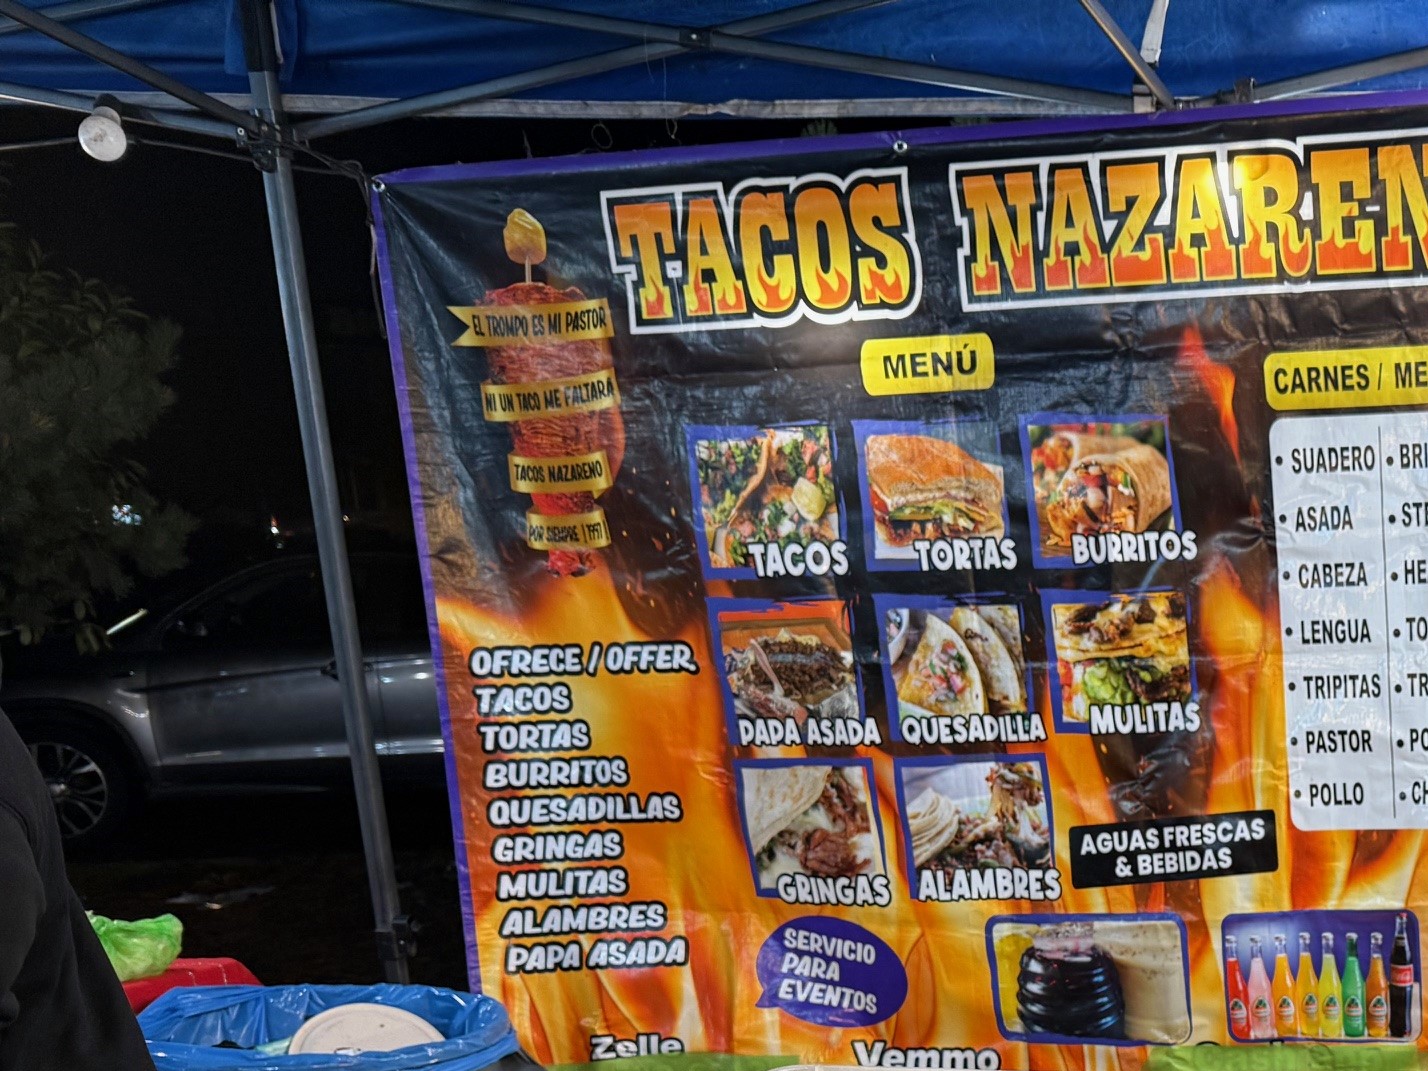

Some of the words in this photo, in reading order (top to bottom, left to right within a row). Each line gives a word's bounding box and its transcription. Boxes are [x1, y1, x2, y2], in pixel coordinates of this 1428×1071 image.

[612, 181, 912, 321] TACOS
[472, 314, 485, 337] EL
[486, 314, 528, 337] TROMPO
[533, 314, 544, 336] ES
[548, 312, 561, 336] MI
[565, 306, 607, 333] PASTOR
[882, 343, 977, 379] MENÚ
[1273, 363, 1370, 395] CARNES
[1376, 362, 1384, 392] /
[485, 392, 496, 413] NI
[500, 393, 515, 412] UN
[516, 391, 541, 412] TACO
[543, 388, 562, 409] ME
[514, 463, 546, 483] TACOS
[548, 460, 603, 483] NAZARENO
[1291, 445, 1376, 474] SUADERO
[1295, 505, 1354, 533] ASADA
[748, 539, 850, 578] TACOS
[913, 536, 1018, 573] TORTAS
[1071, 530, 1199, 567] BURRITOS
[1298, 562, 1369, 589] CABEZA
[1301, 618, 1372, 645] LENGUA
[470, 647, 583, 676] OFRECE
[587, 643, 602, 675] /
[475, 685, 571, 715] TACOS
[1303, 673, 1382, 700] TRIPITAS
[738, 716, 800, 747] PAPA
[806, 715, 882, 747] ASADA
[899, 712, 1047, 745] QUESADILLA
[1088, 701, 1201, 736] MULITAS
[480, 722, 590, 752] TORTAS
[1306, 729, 1373, 754] PASTOR
[485, 758, 629, 789] BURRITOS
[489, 794, 682, 826] QUESADILLAS
[1309, 782, 1365, 807] POLLO
[493, 831, 623, 864] GRINGAS
[1080, 829, 1160, 857] AGUAS
[1163, 816, 1266, 848] FRESCAS
[1115, 857, 1133, 879] &
[1137, 847, 1233, 876] BEBIDAS
[497, 868, 628, 900] MULITAS
[777, 872, 891, 906] GRINGAS
[918, 867, 1062, 901] ALAMBRES
[501, 903, 666, 937] ALAMBRES
[507, 942, 582, 973] PAPA
[587, 937, 687, 967] ASADA
[783, 927, 876, 966] SERVICIO
[781, 952, 841, 982] PARA
[778, 977, 878, 1015] EVENTOS
[590, 1033, 685, 1060] Zelle
[853, 1040, 1001, 1069] Vemmo
